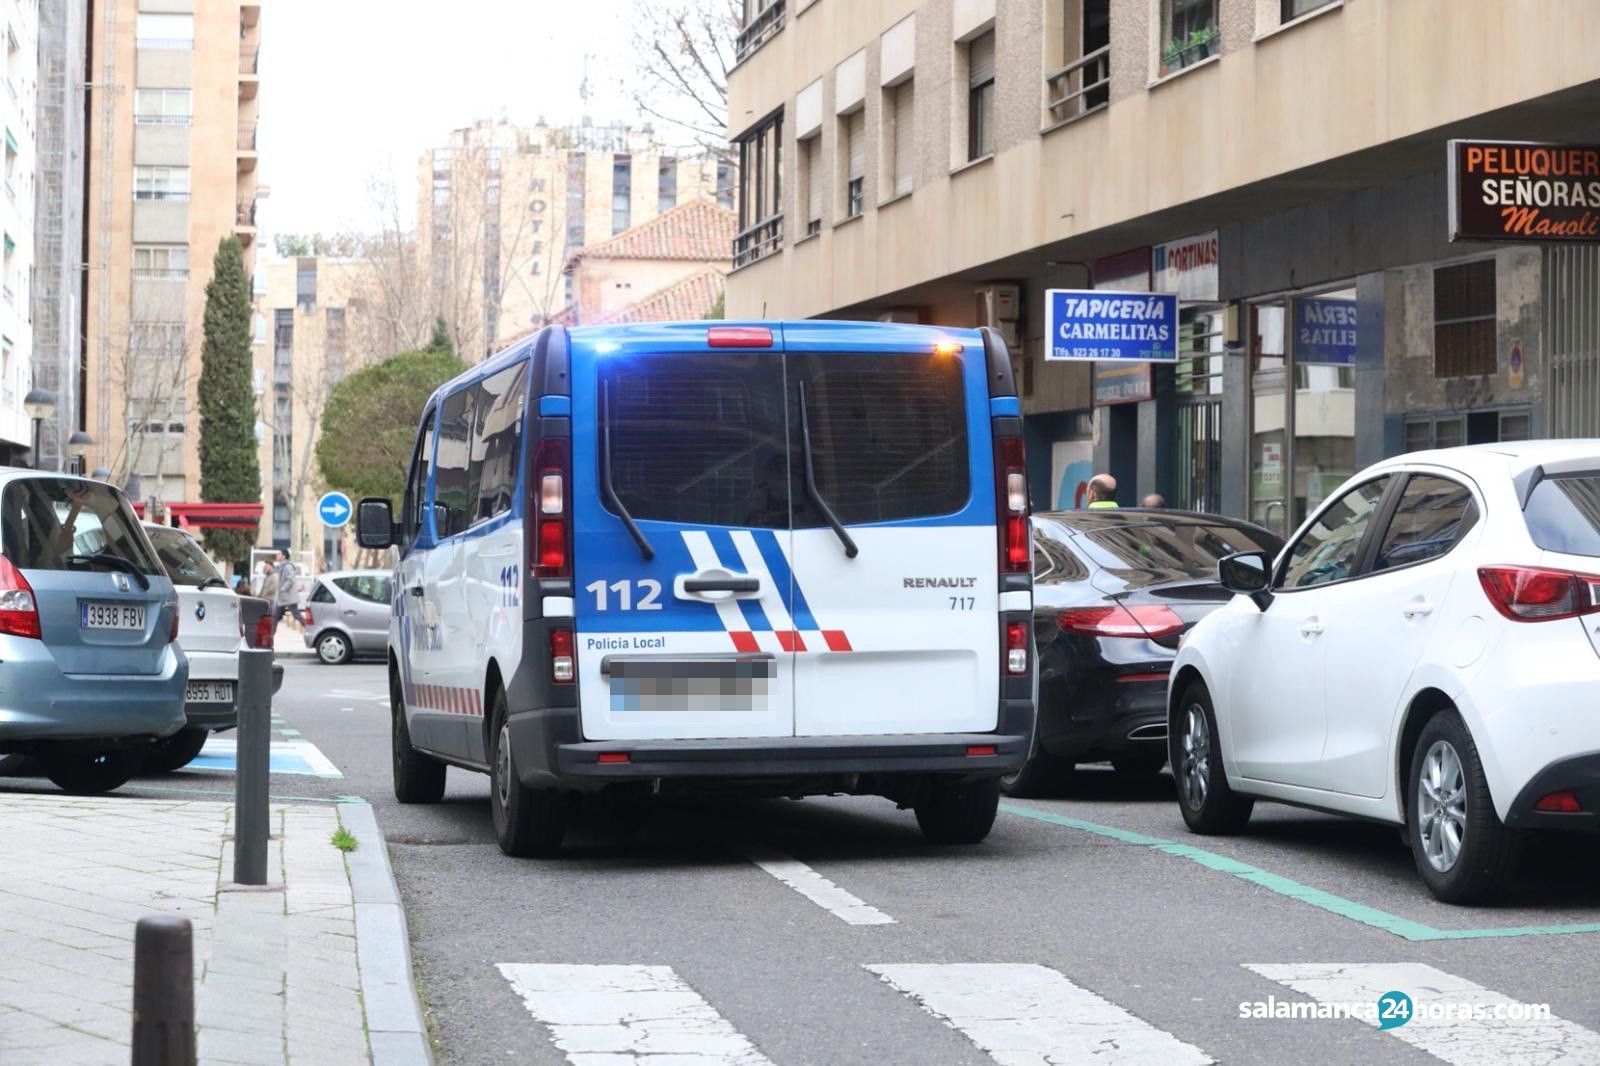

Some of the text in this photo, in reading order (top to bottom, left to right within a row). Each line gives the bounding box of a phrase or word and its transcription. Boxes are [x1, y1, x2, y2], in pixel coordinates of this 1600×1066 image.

[1467, 147, 1600, 176] PELUQUER
[1482, 176, 1600, 207] SEÑORAS
[528, 178, 547, 276] HOTEL
[1168, 238, 1217, 277] CORTINAS
[1065, 297, 1165, 320] TAPICERÍA
[1059, 322, 1169, 341] CARMELITAS
[1072, 347, 1087, 358] 923
[1088, 347, 1098, 358] 26
[1100, 347, 1110, 358] 17
[501, 565, 518, 608] 112
[903, 577, 977, 588] RENAULT
[585, 579, 663, 611] 112
[949, 597, 975, 610] 717
[89, 606, 144, 628] 3938 FBV
[587, 636, 665, 650] Policía Local
[214, 683, 232, 700] HDT
